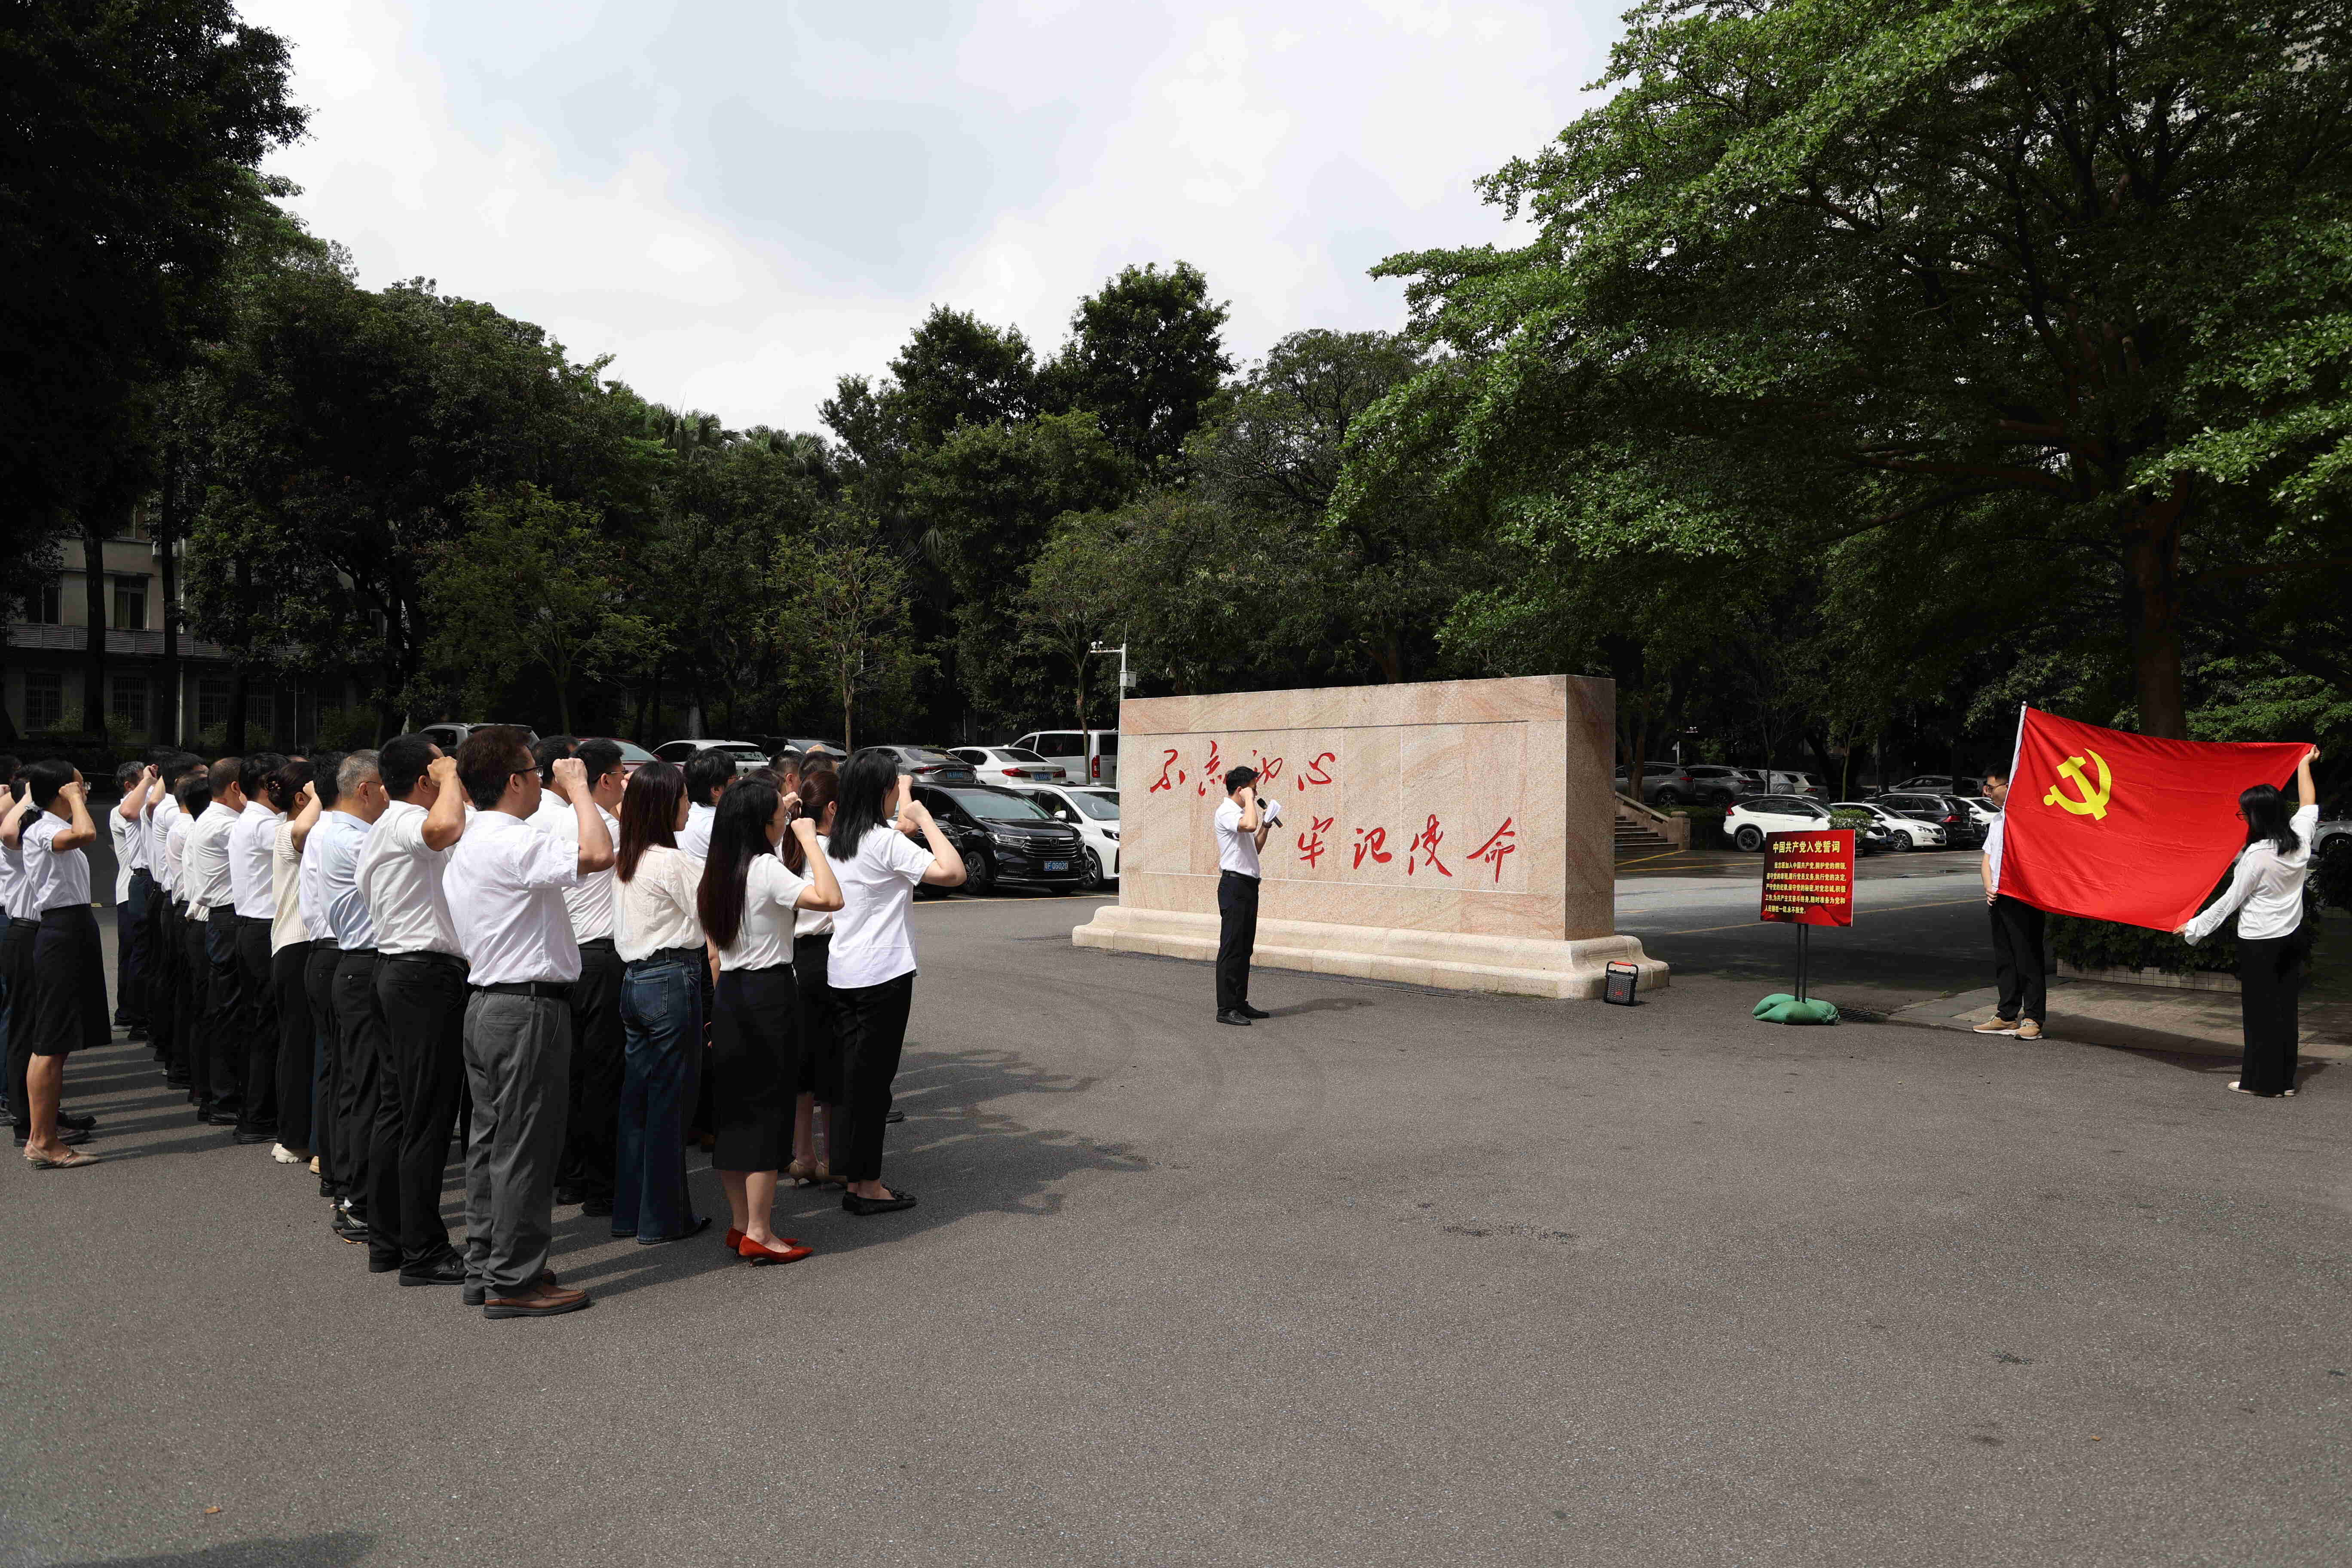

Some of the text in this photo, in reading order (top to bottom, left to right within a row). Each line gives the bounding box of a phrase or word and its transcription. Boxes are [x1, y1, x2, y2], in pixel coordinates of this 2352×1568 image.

[1297, 814, 1516, 884] 牢记使命
[1773, 840, 1841, 853] 中国共产党入党誓词
